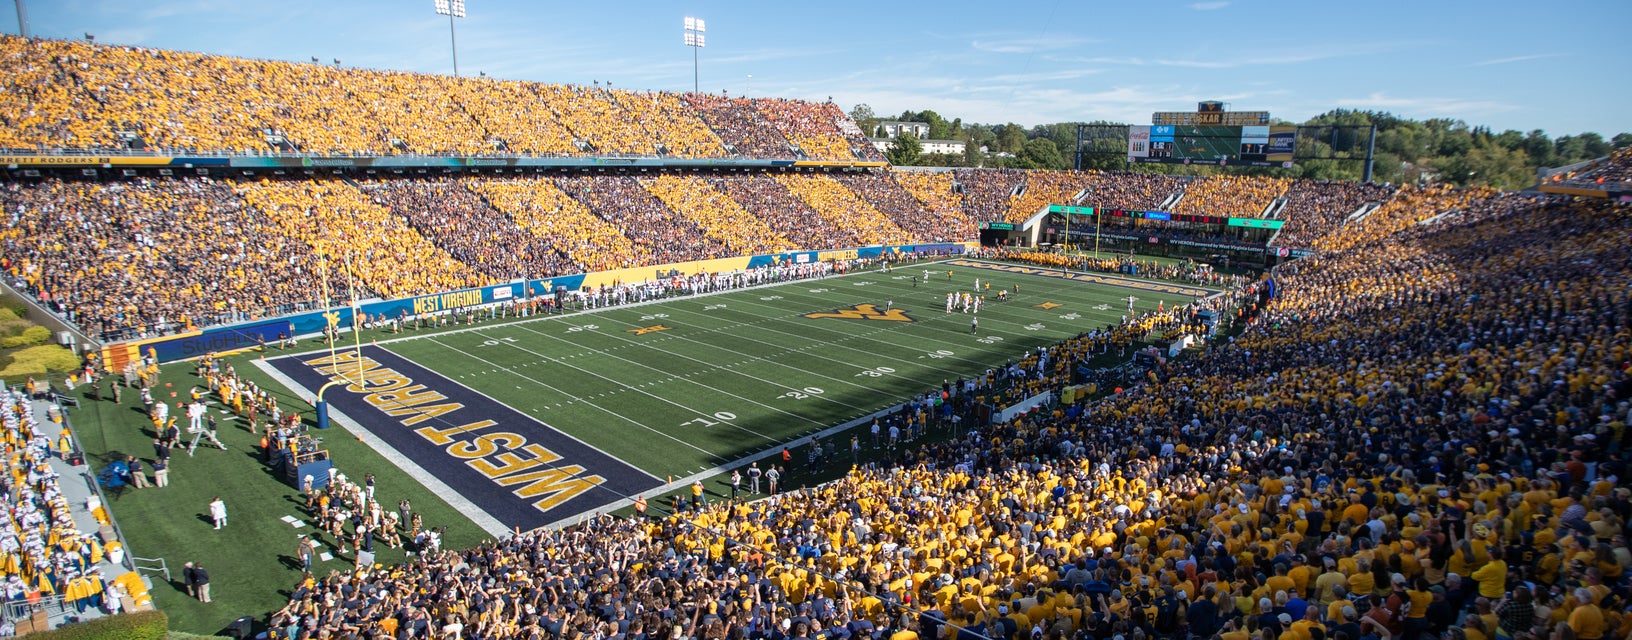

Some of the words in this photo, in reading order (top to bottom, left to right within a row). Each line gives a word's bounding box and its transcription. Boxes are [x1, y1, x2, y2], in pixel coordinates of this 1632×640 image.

[413, 296, 440, 315] WEST
[440, 289, 483, 311] VIRGINIA
[182, 331, 258, 355] StubHub
[929, 349, 955, 361] 40
[865, 365, 897, 379] 30
[302, 350, 466, 427] VIRGINIA
[786, 386, 826, 401] 20
[695, 410, 737, 428] 10
[413, 418, 608, 513] WEST
